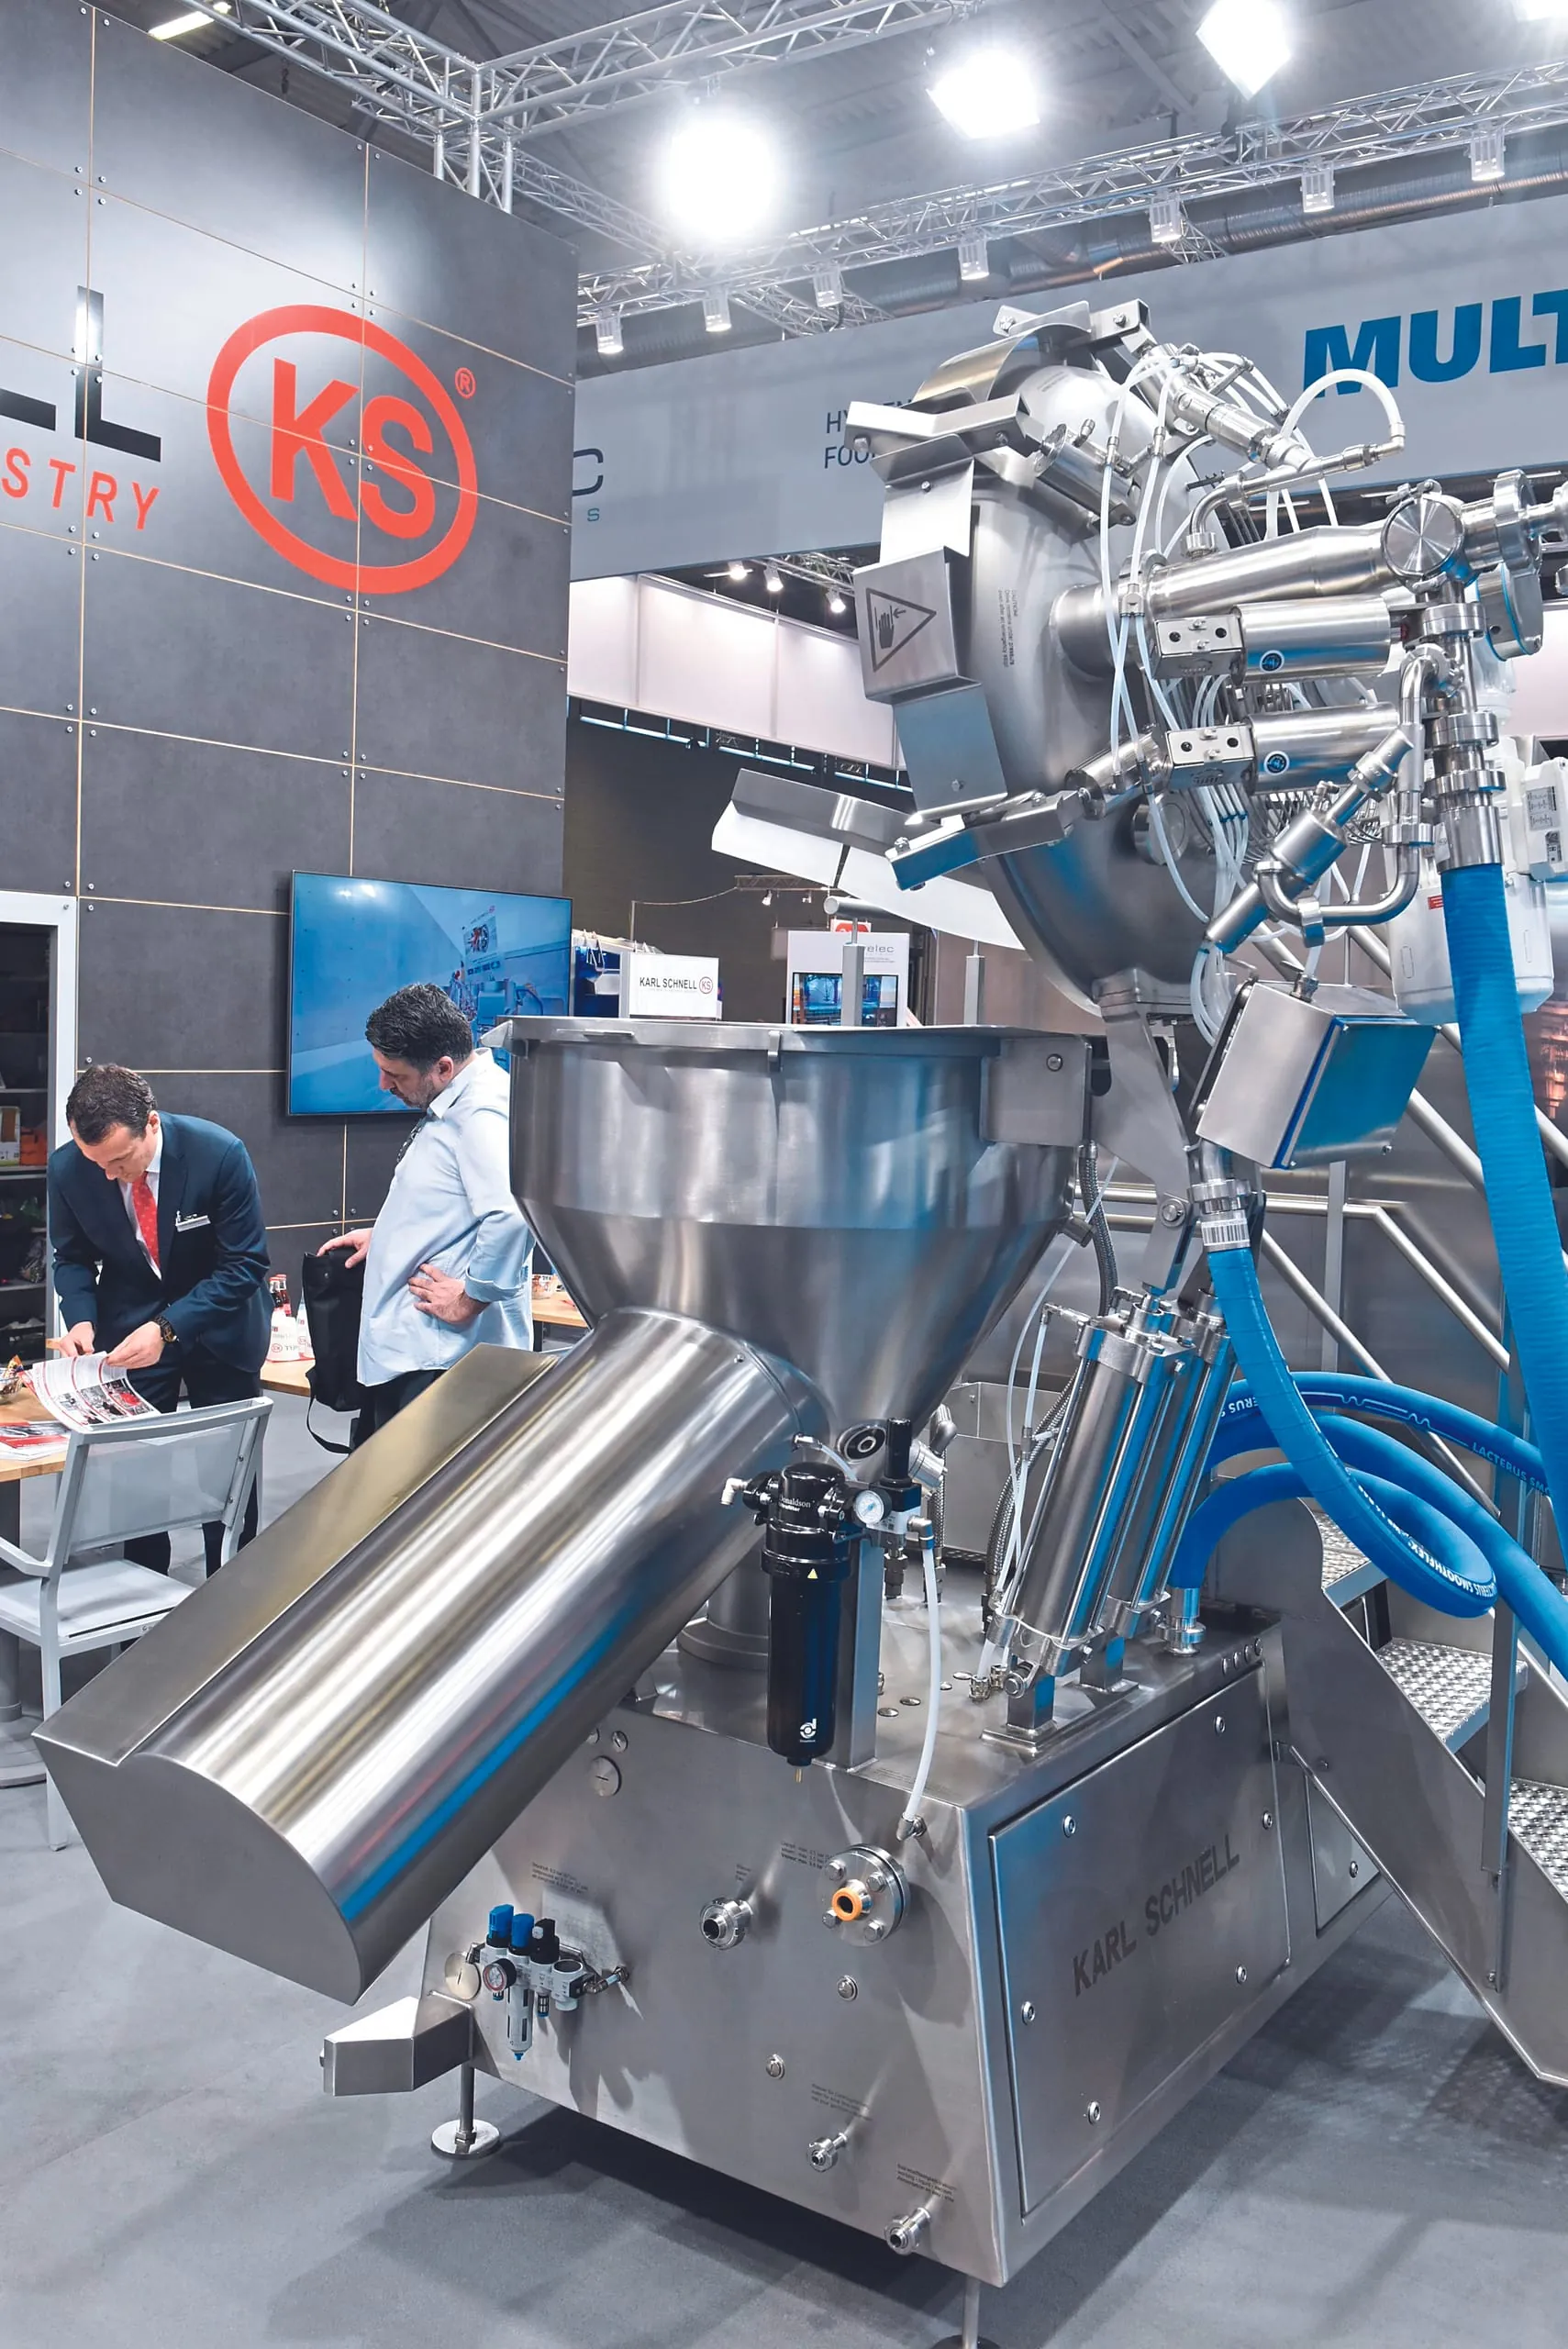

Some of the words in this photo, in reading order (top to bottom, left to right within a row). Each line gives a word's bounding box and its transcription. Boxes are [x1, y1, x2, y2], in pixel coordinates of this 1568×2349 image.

[270, 357, 436, 540] KS
[825, 445, 875, 469] FOO
[1, 447, 160, 531] STRY
[639, 977, 661, 987] KARL
[662, 978, 697, 989] SCHNELL
[1473, 1442, 1528, 1481] LACTERUS
[1073, 1919, 1138, 1998] KARL
[1145, 1832, 1240, 1937] SCHNELL
